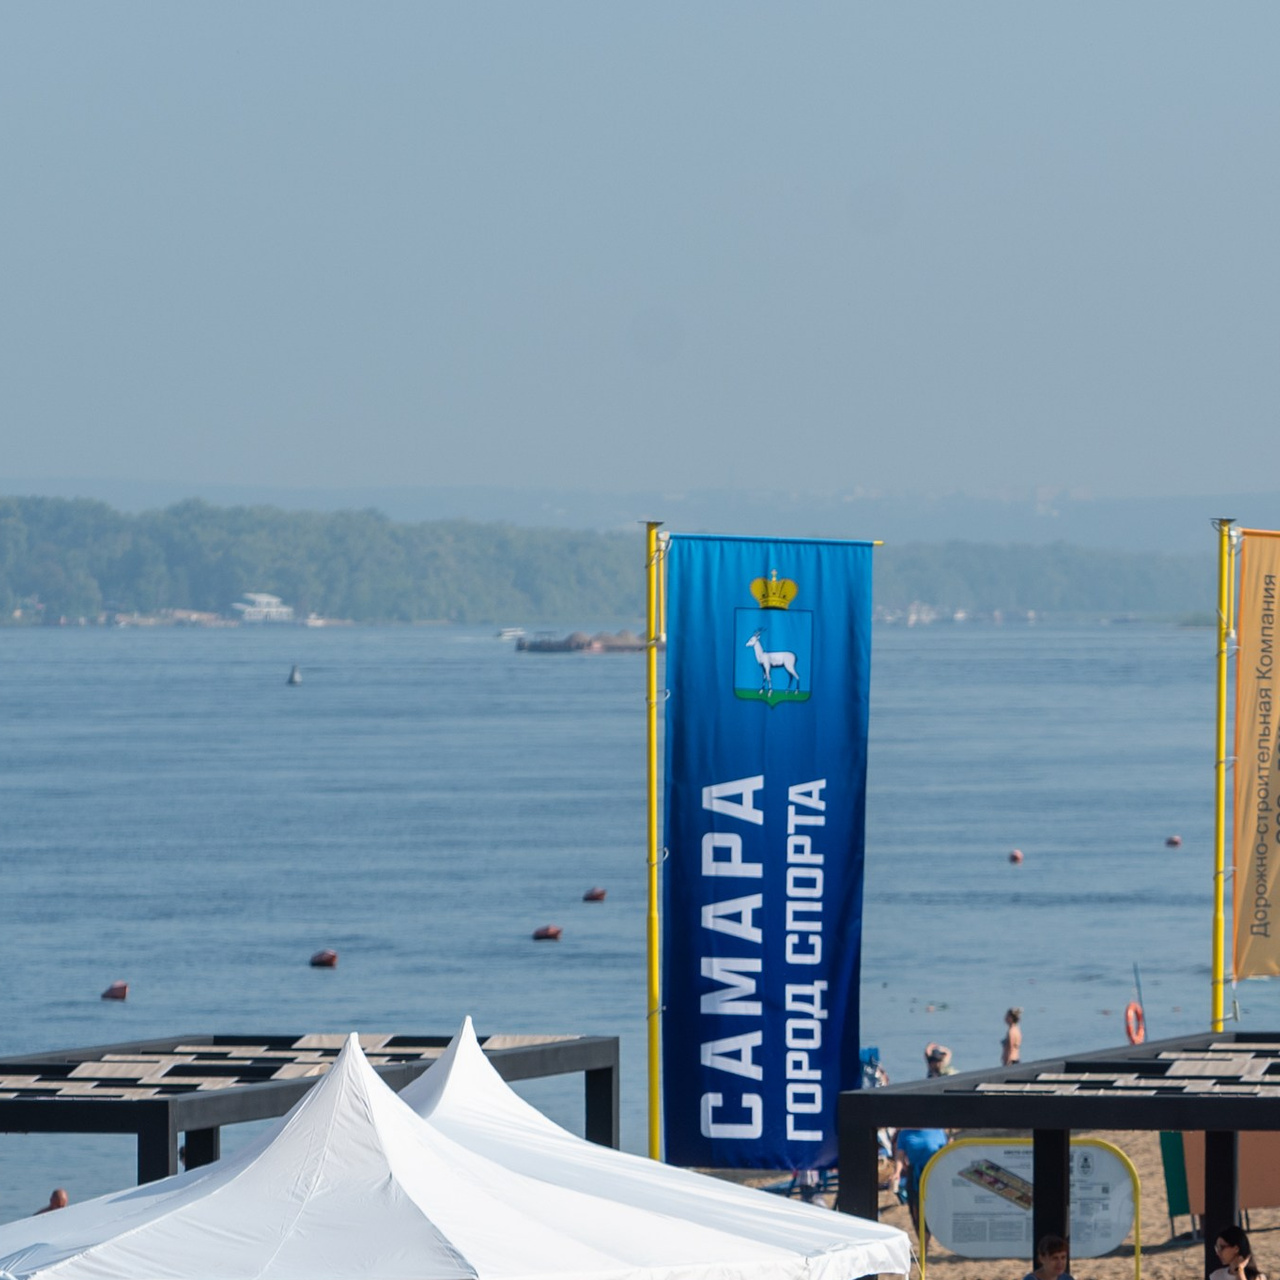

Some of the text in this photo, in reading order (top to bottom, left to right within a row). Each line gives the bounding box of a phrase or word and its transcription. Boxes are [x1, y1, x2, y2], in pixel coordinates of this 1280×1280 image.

[1250, 574, 1276, 938] Дорожно-строительная Компания
[700, 774, 765, 1140] САМАРА
[785, 778, 828, 1141] ГОРОД СПОРТА
